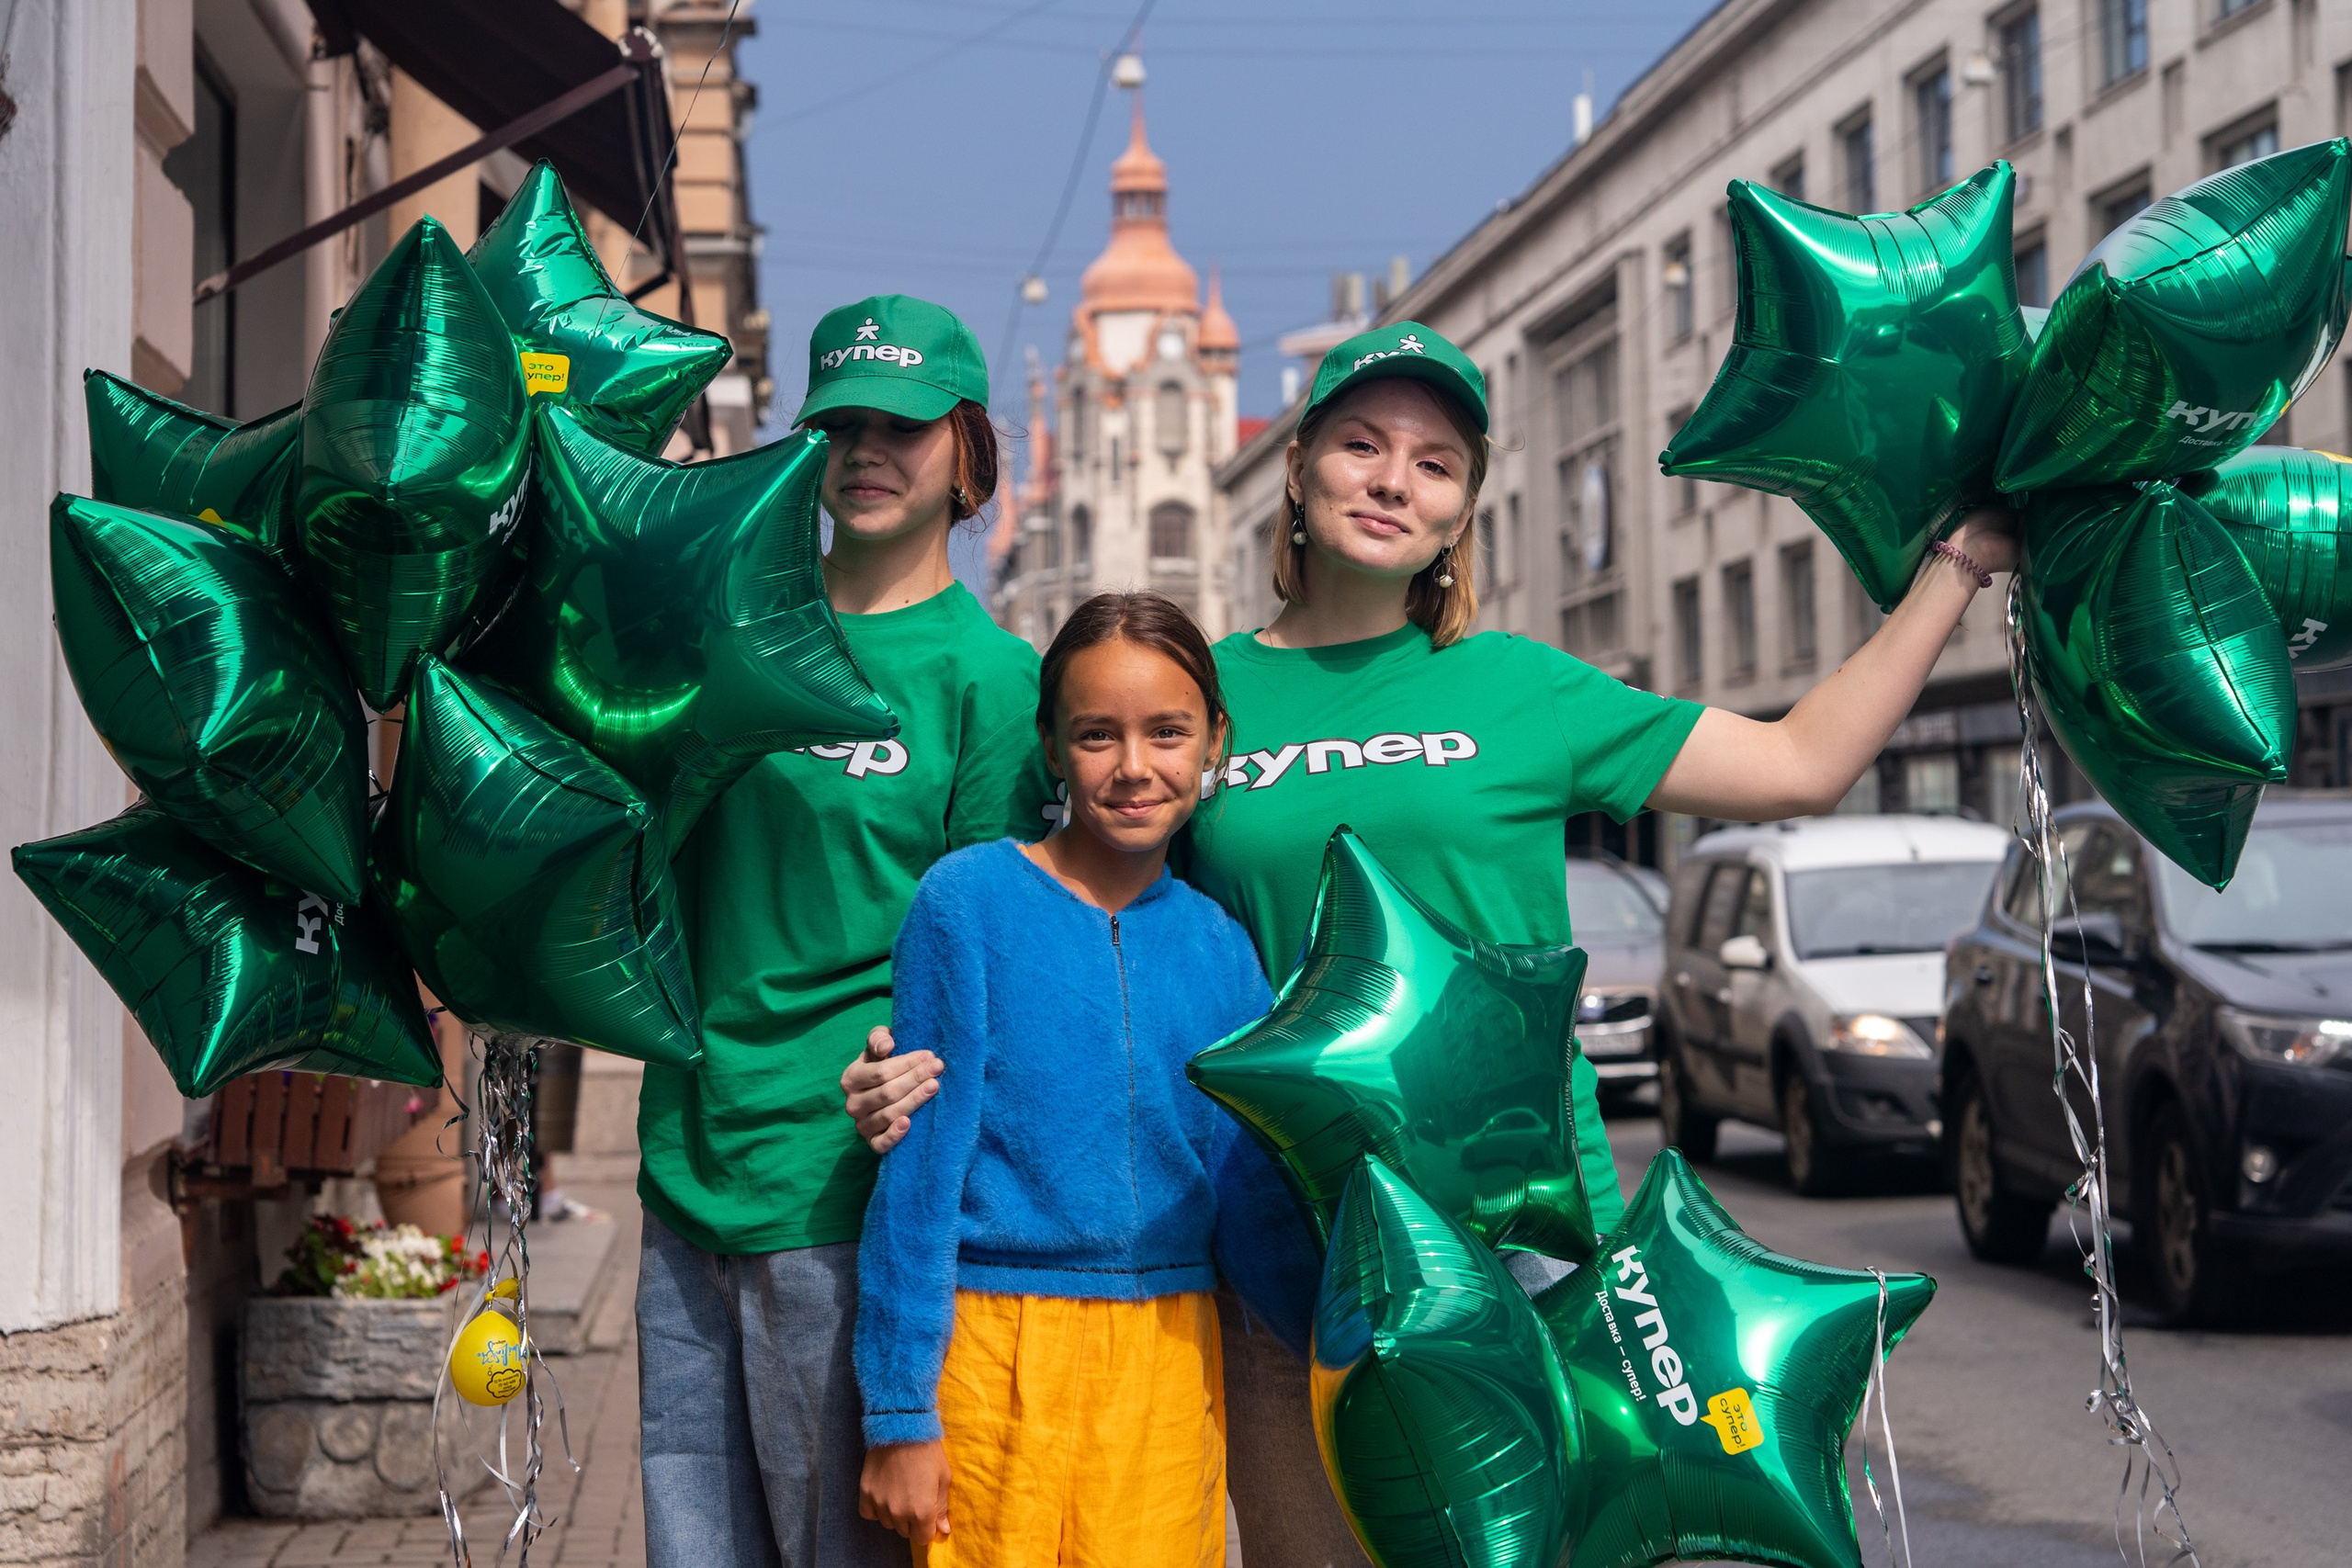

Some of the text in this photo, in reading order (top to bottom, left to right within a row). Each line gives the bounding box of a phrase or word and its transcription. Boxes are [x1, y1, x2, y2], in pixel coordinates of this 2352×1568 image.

[528, 363, 554, 371] это
[820, 343, 924, 373] купер
[526, 372, 565, 382] упер!
[2178, 435, 2222, 446] Доставка
[1200, 730, 1480, 801] купер
[1595, 1291, 1623, 1344] Доставка
[1622, 1359, 1647, 1402] супер!
[1611, 1245, 1699, 1426] купер
[1720, 1397, 1746, 1449] супер!
[1733, 1404, 1747, 1432] это
